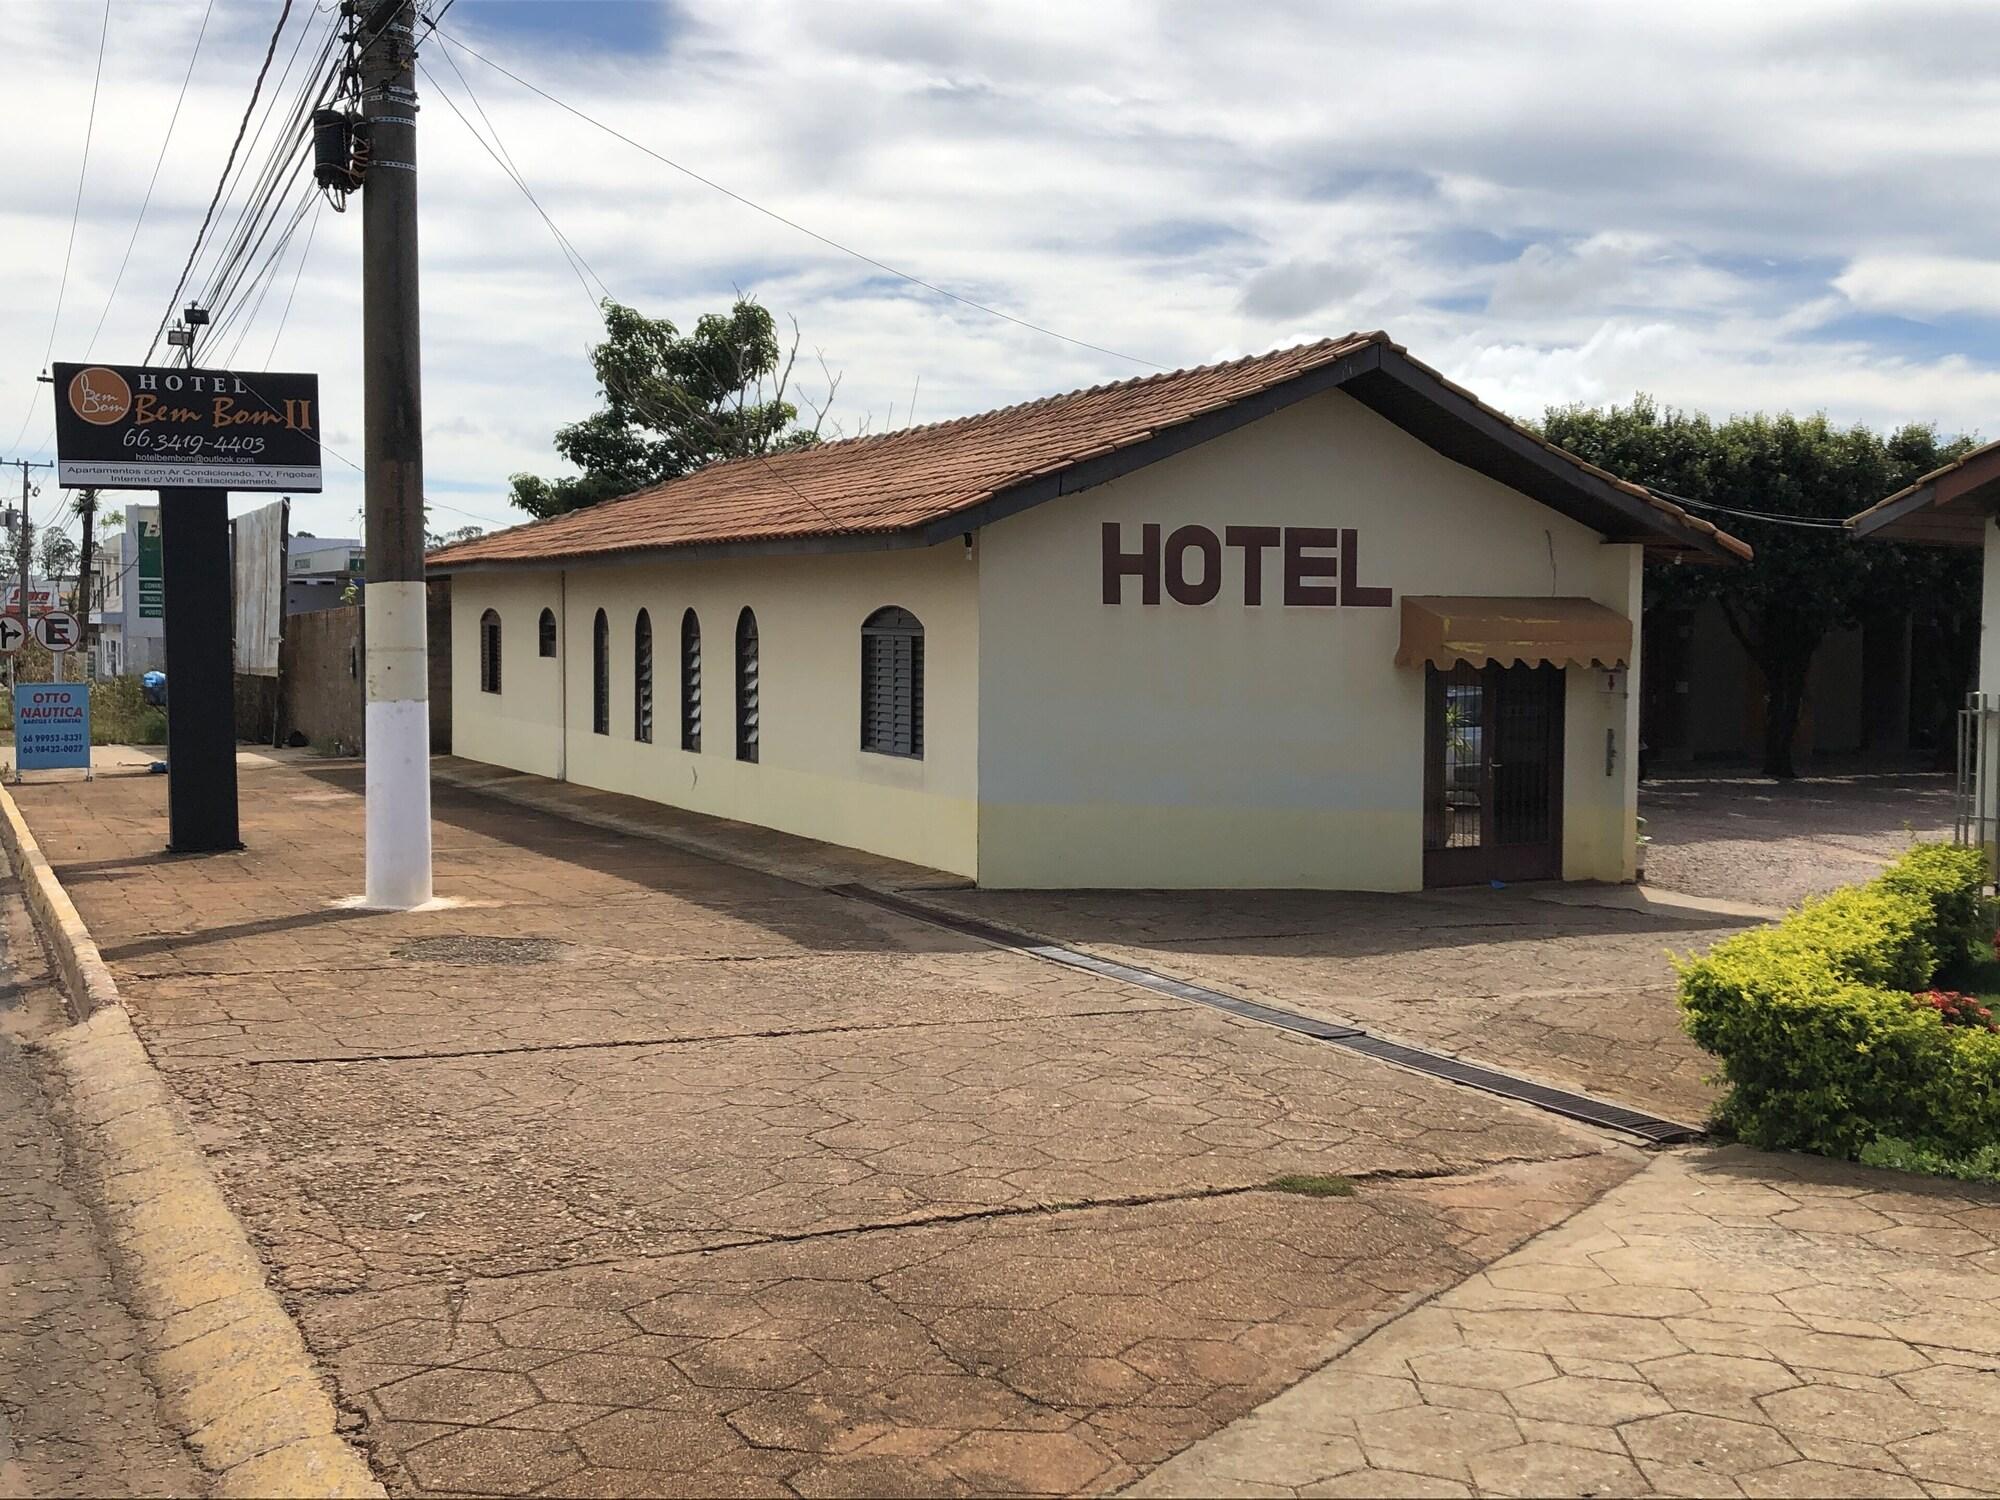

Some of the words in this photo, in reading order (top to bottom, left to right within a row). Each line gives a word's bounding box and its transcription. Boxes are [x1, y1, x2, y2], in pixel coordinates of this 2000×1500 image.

[138, 374, 247, 394] HOTEL
[134, 394, 202, 427] Bem
[212, 396, 284, 429] Bom
[282, 398, 312, 430] II
[123, 428, 265, 454] 66.3419-4403
[67, 466, 141, 475] Apartamentos
[143, 468, 166, 476] com
[168, 468, 181, 476] Ar
[111, 475, 151, 483] Internet
[164, 476, 185, 484] Wifi
[1101, 522, 1393, 607] HOTEL
[46, 619, 70, 644] E
[33, 692, 71, 704] OTTO
[23, 734, 33, 743] 66
[23, 745, 33, 754] 66
